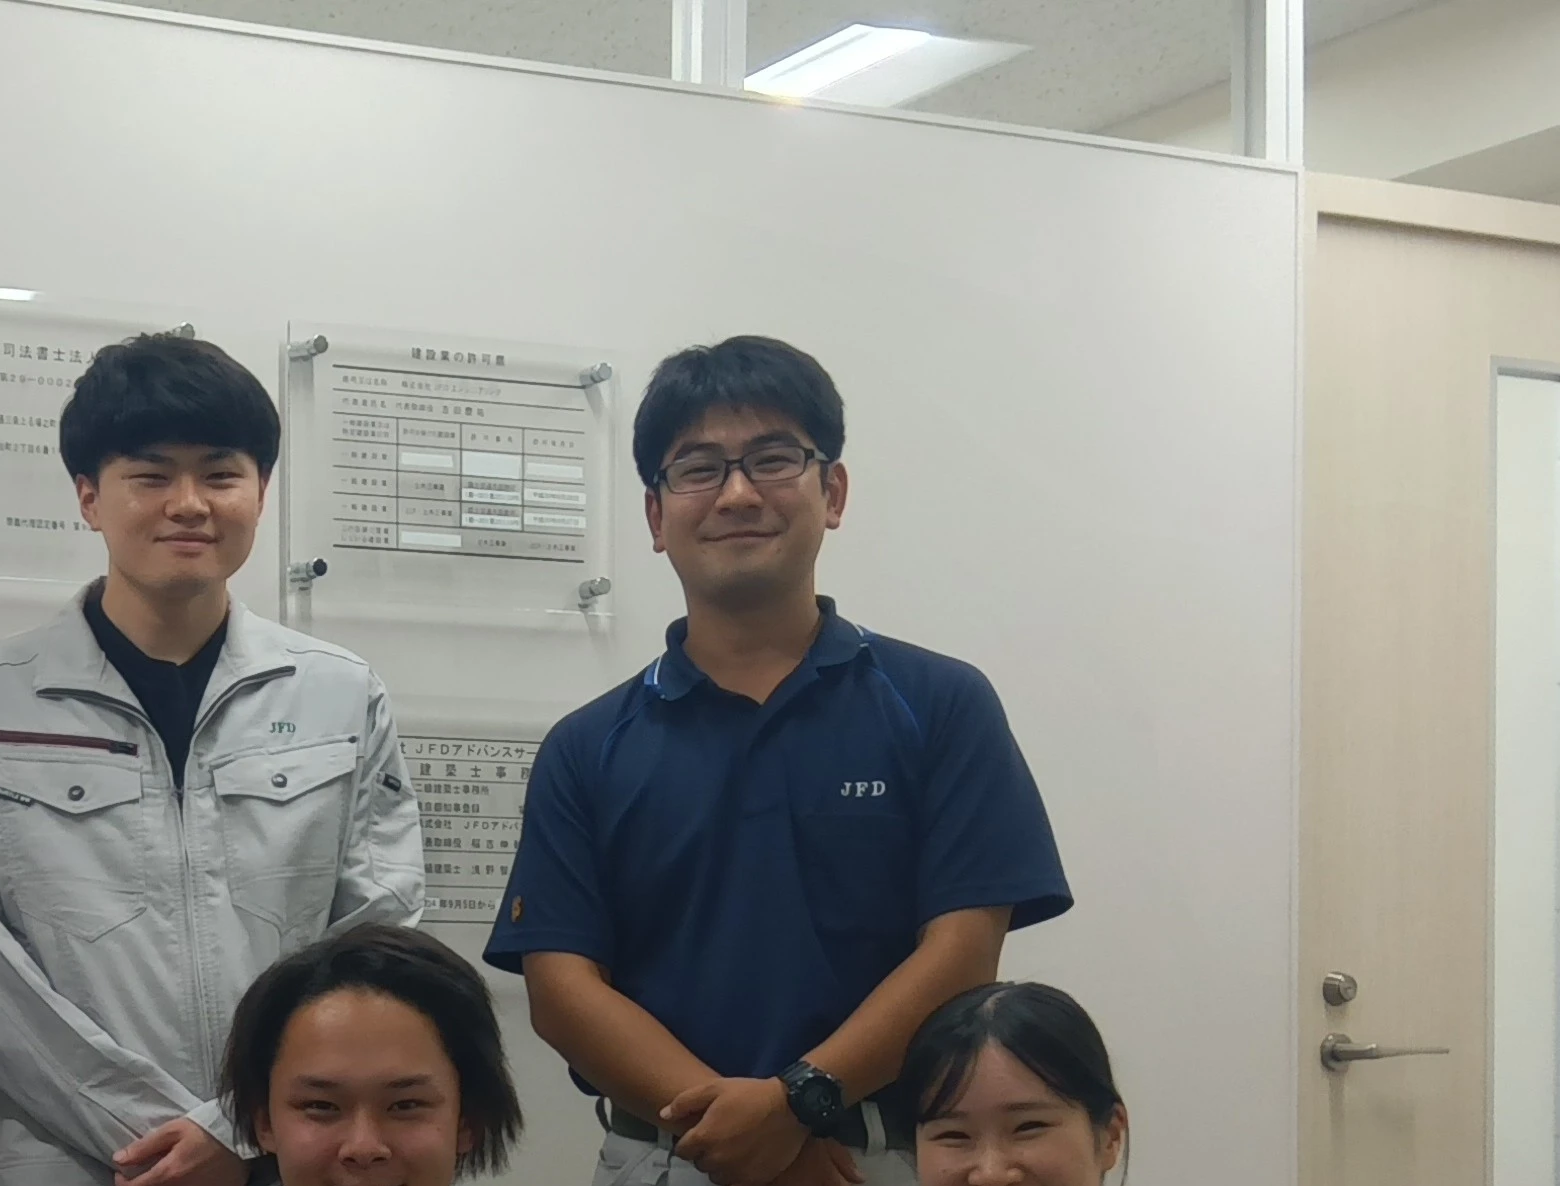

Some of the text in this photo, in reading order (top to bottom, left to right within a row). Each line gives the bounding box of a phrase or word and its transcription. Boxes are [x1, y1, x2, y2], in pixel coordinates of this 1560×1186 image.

[411, 346, 506, 367] 建設業の許可票
[269, 722, 297, 734] JFD
[840, 780, 887, 798] JFD
